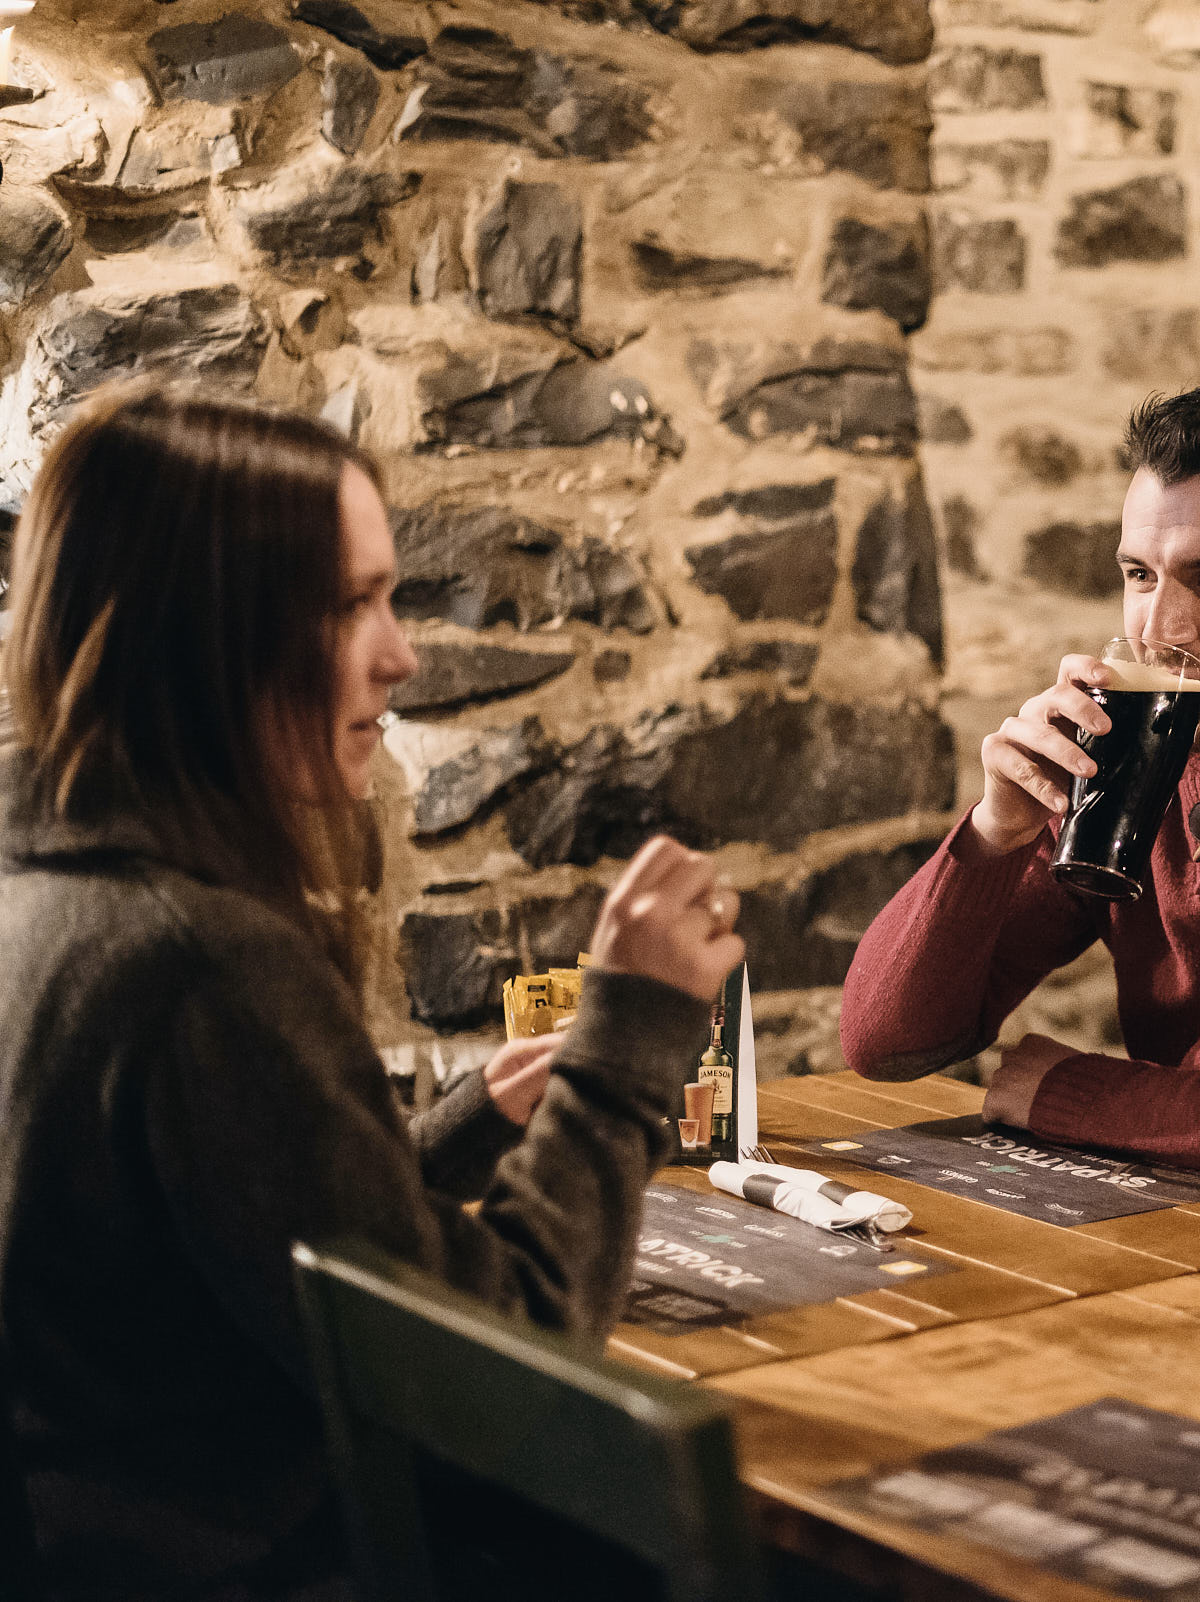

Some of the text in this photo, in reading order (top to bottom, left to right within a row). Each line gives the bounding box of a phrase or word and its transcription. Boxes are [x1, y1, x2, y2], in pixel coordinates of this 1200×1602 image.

[700, 1069, 731, 1079] JAMESON
[961, 1132, 1112, 1179] PATRICK
[636, 1237, 765, 1288] ATRICK
